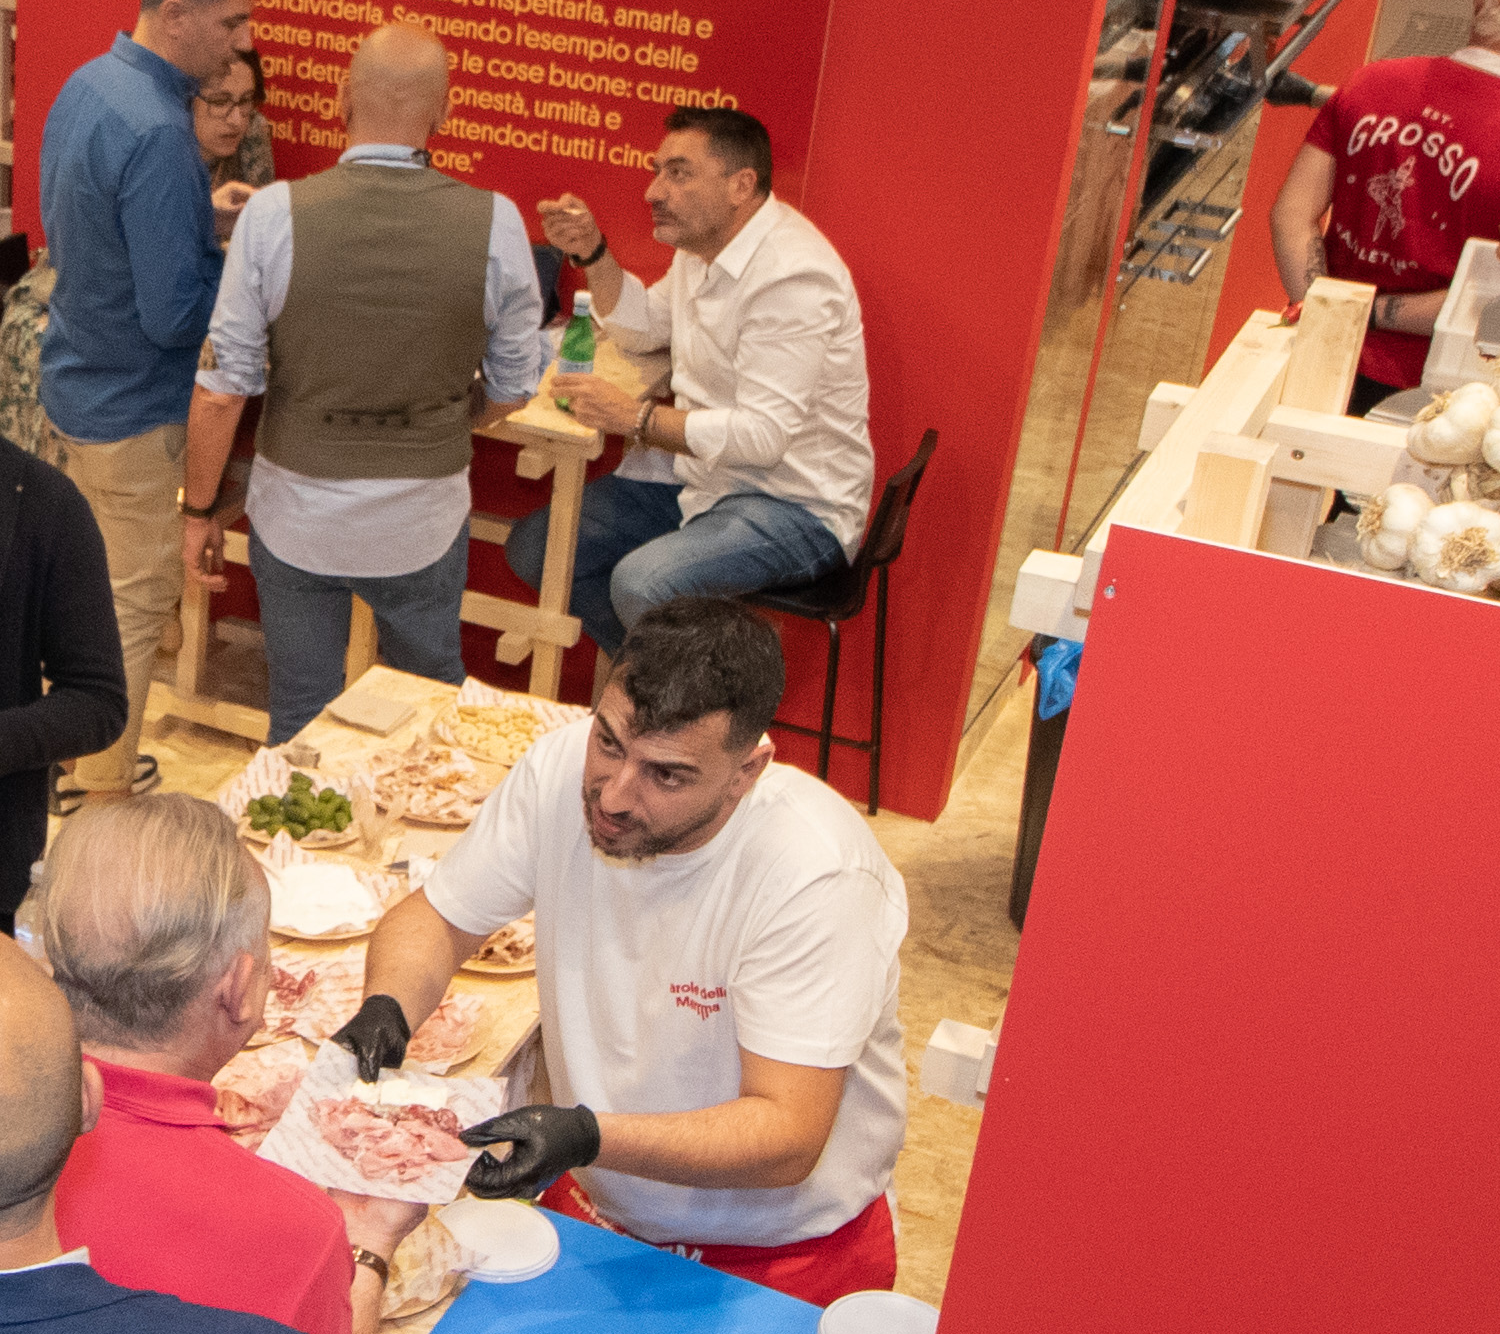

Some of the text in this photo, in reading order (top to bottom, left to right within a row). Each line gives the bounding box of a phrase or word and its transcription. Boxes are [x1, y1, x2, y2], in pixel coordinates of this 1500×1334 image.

[614, 8, 690, 35] amarla
[696, 20, 713, 38] e
[635, 43, 698, 72] delle
[463, 50, 483, 73] le
[487, 59, 544, 83] cose
[549, 63, 631, 97] buone:
[637, 82, 737, 109] curando
[450, 85, 530, 116] onestà,
[535, 101, 600, 126] umiltà
[605, 112, 621, 129] e
[552, 135, 594, 159] tutti
[1346, 114, 1479, 201] GROSSO
[669, 981, 700, 1006] arole
